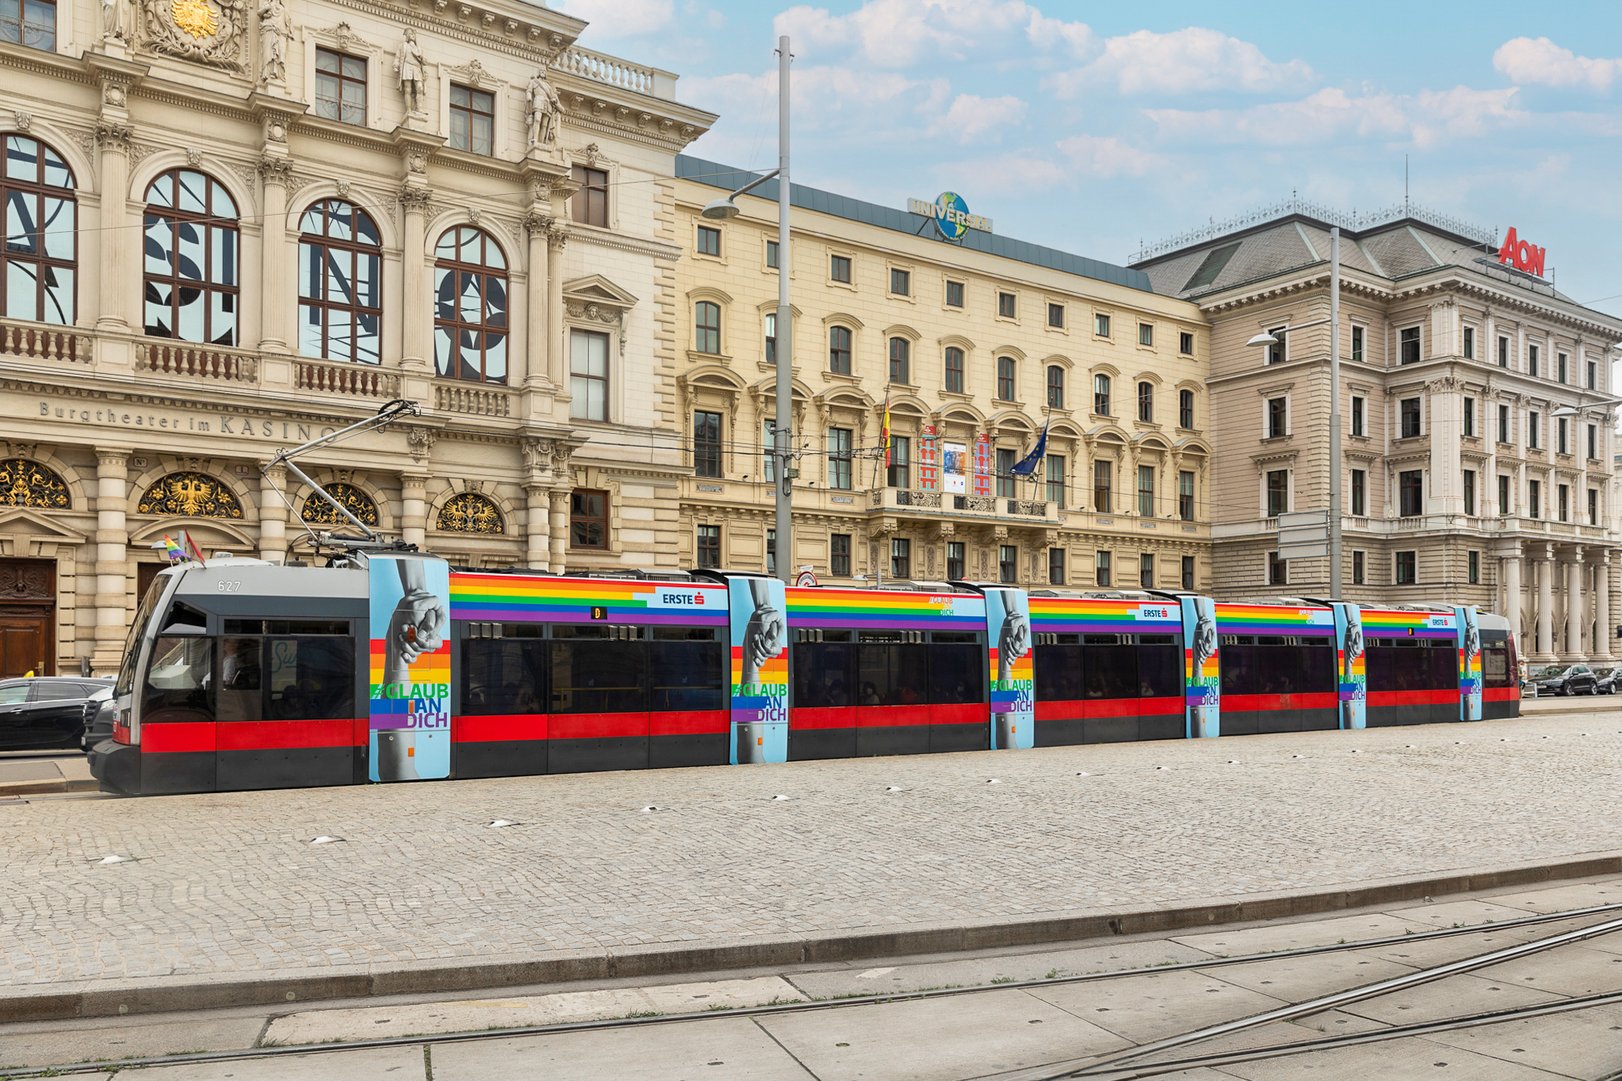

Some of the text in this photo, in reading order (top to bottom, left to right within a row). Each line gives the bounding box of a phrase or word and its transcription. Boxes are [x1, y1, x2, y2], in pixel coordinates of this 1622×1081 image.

[1498, 226, 1545, 278] AON
[39, 401, 337, 445] Burgtheater im KASINO
[218, 580, 241, 592] 627
[663, 594, 693, 605] ERSTE
[1144, 609, 1161, 618] ERSTE
[371, 683, 449, 699] #GLAUB
[732, 683, 787, 697] #GLAUB
[991, 679, 1032, 691] #GLAUB
[1014, 690, 1029, 701] AN
[1201, 695, 1218, 705] DICH
[414, 698, 442, 713] AN
[762, 696, 782, 709] AN
[1010, 700, 1032, 712] DICH
[407, 712, 448, 728] DICH
[757, 708, 786, 721] DICH
